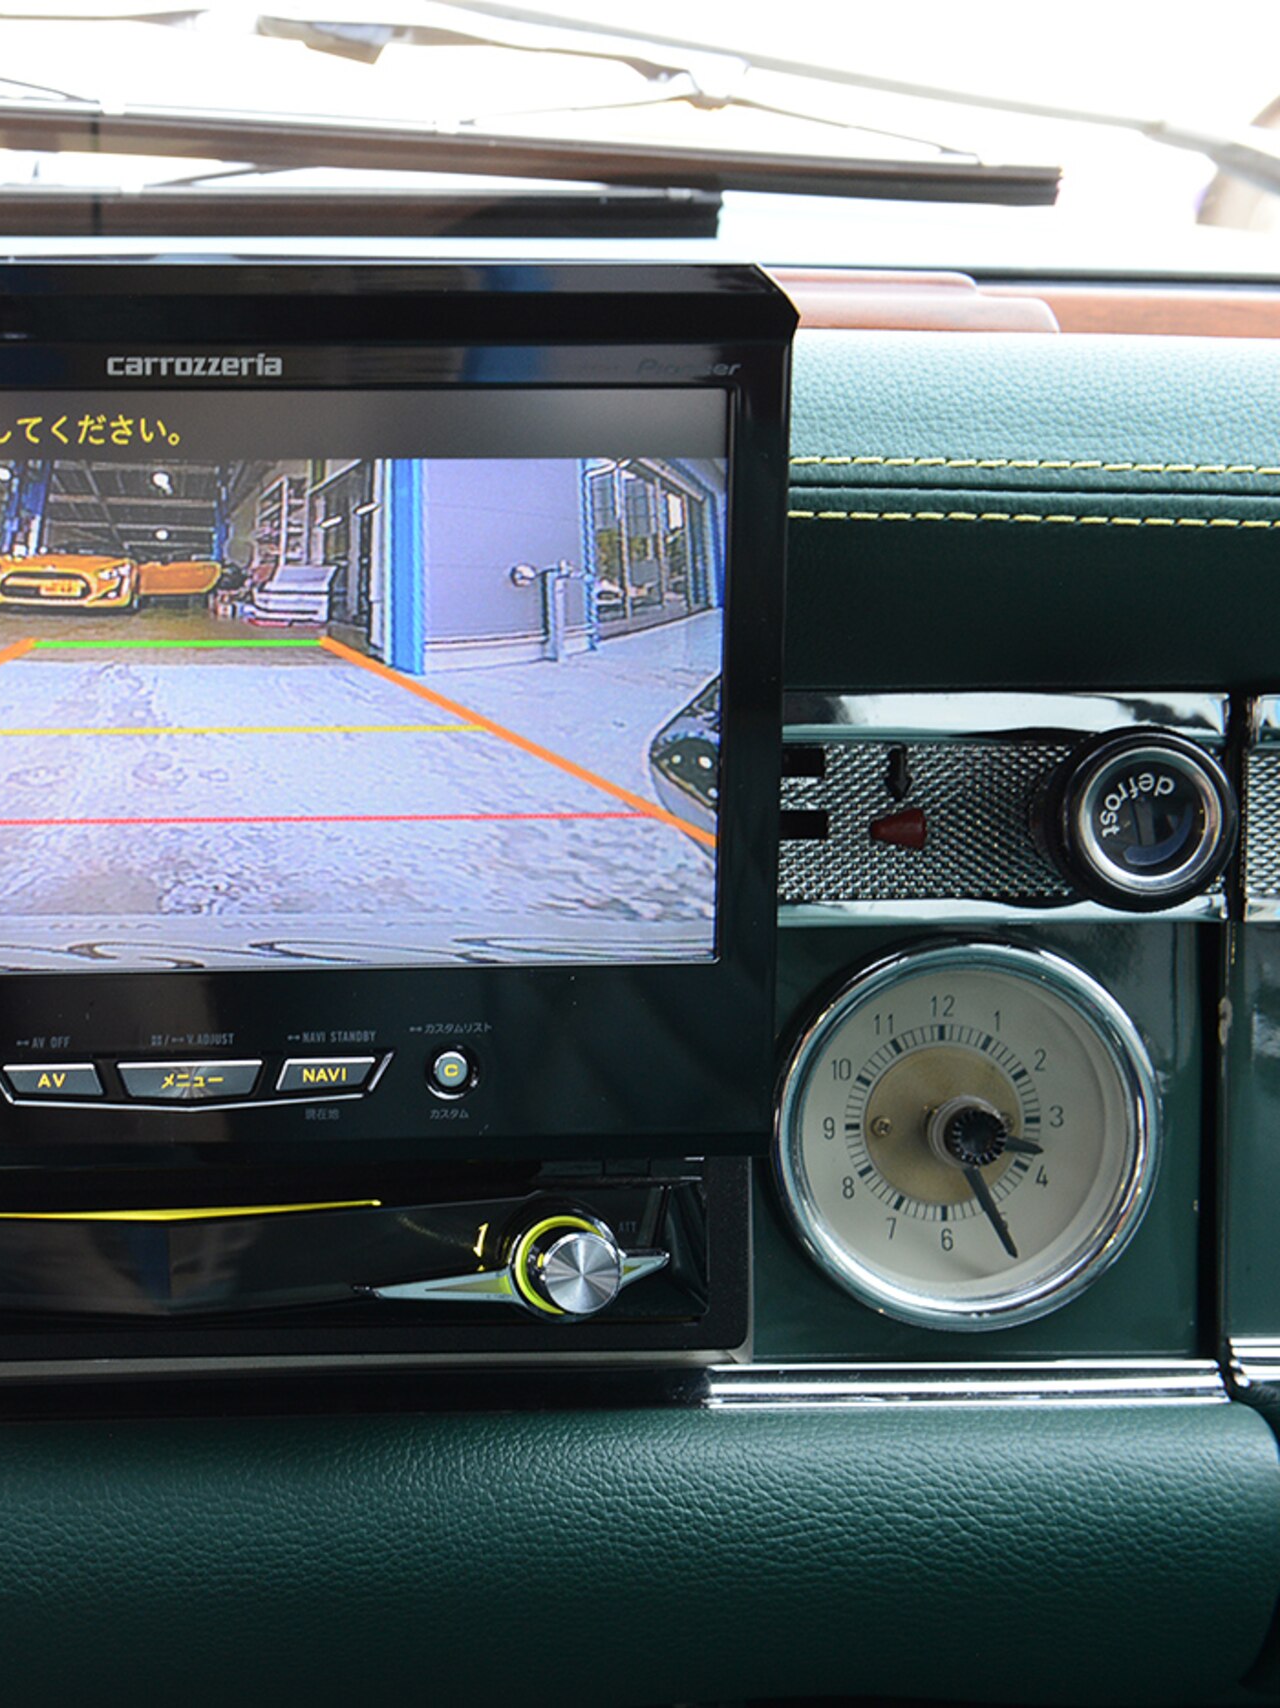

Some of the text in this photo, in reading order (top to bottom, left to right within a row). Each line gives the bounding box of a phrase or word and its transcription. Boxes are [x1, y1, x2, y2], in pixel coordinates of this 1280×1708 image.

[107, 353, 283, 376] carrozzeria
[1100, 772, 1175, 838] defrost
[931, 995, 955, 1018] 12
[873, 1013, 894, 1035] 11
[994, 1010, 1001, 1031] 1
[31, 1036, 71, 1049] AV OFF
[302, 1030, 376, 1043] NAVI STANDBY
[444, 1063, 459, 1078] C
[831, 1057, 852, 1081] 10
[1034, 1048, 1047, 1072] 2
[38, 1073, 66, 1088] AV
[161, 1073, 224, 1089] メニュー
[303, 1068, 347, 1083] NAVI
[429, 1108, 470, 1120] カスタム
[1049, 1105, 1065, 1128] 3
[822, 1116, 835, 1140] 9
[1035, 1165, 1049, 1187] 4
[842, 1176, 855, 1200] 8
[885, 1216, 897, 1240] 7
[940, 1228, 954, 1252] 6
